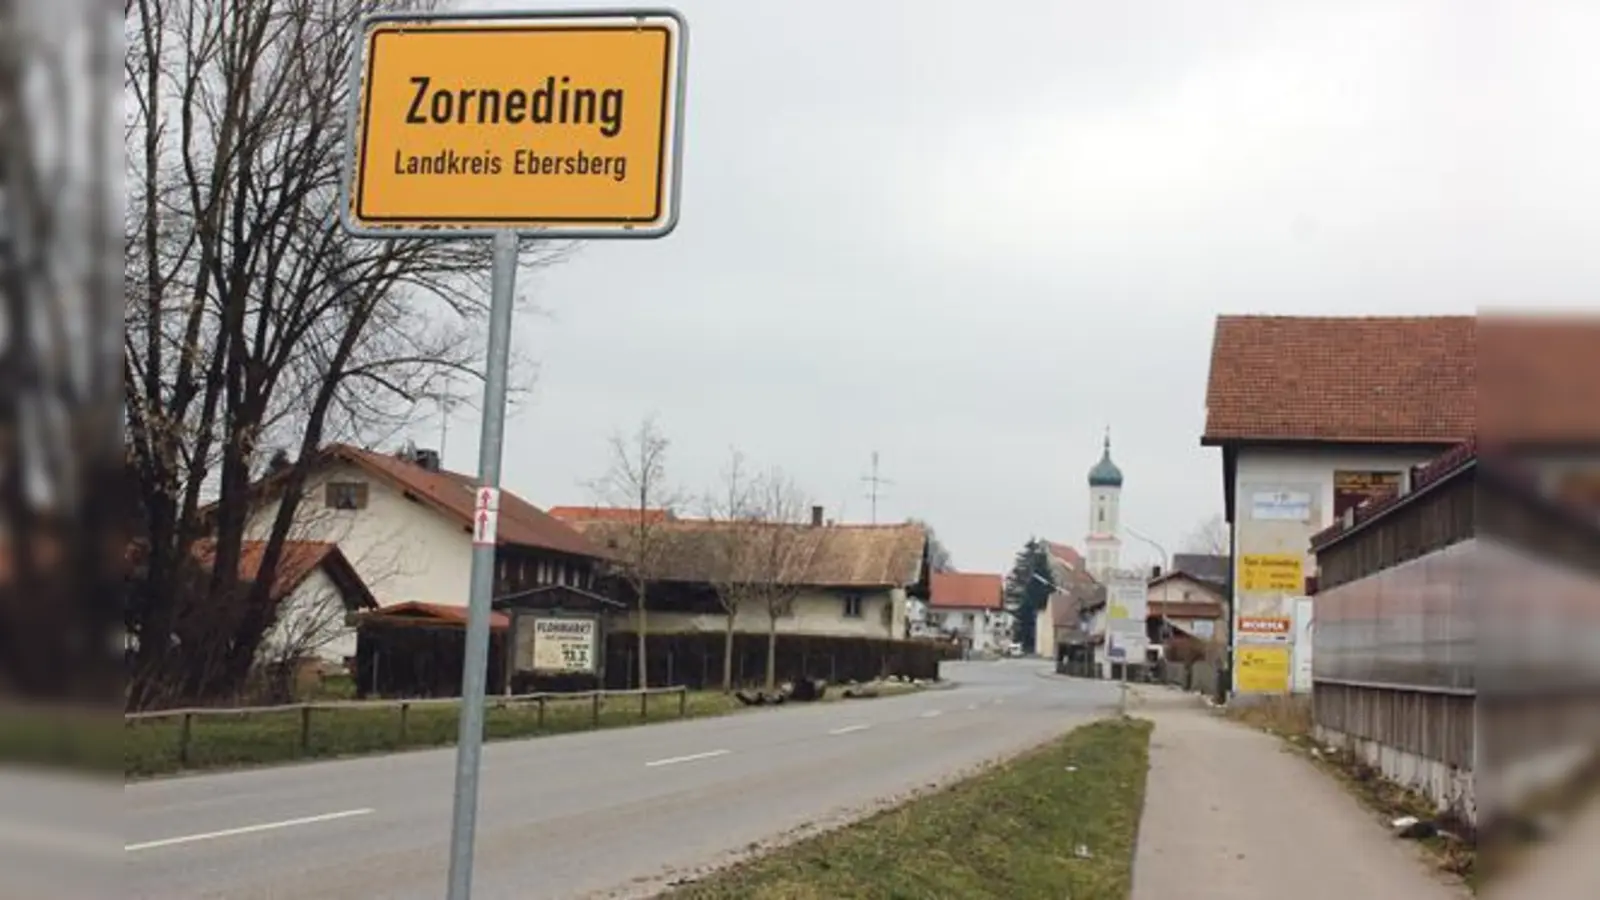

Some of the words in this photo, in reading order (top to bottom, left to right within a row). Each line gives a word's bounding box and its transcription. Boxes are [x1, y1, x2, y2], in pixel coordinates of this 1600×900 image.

[406, 76, 624, 137] Zorneding
[394, 149, 502, 175] Landkreis
[513, 149, 627, 182] Ebersberg
